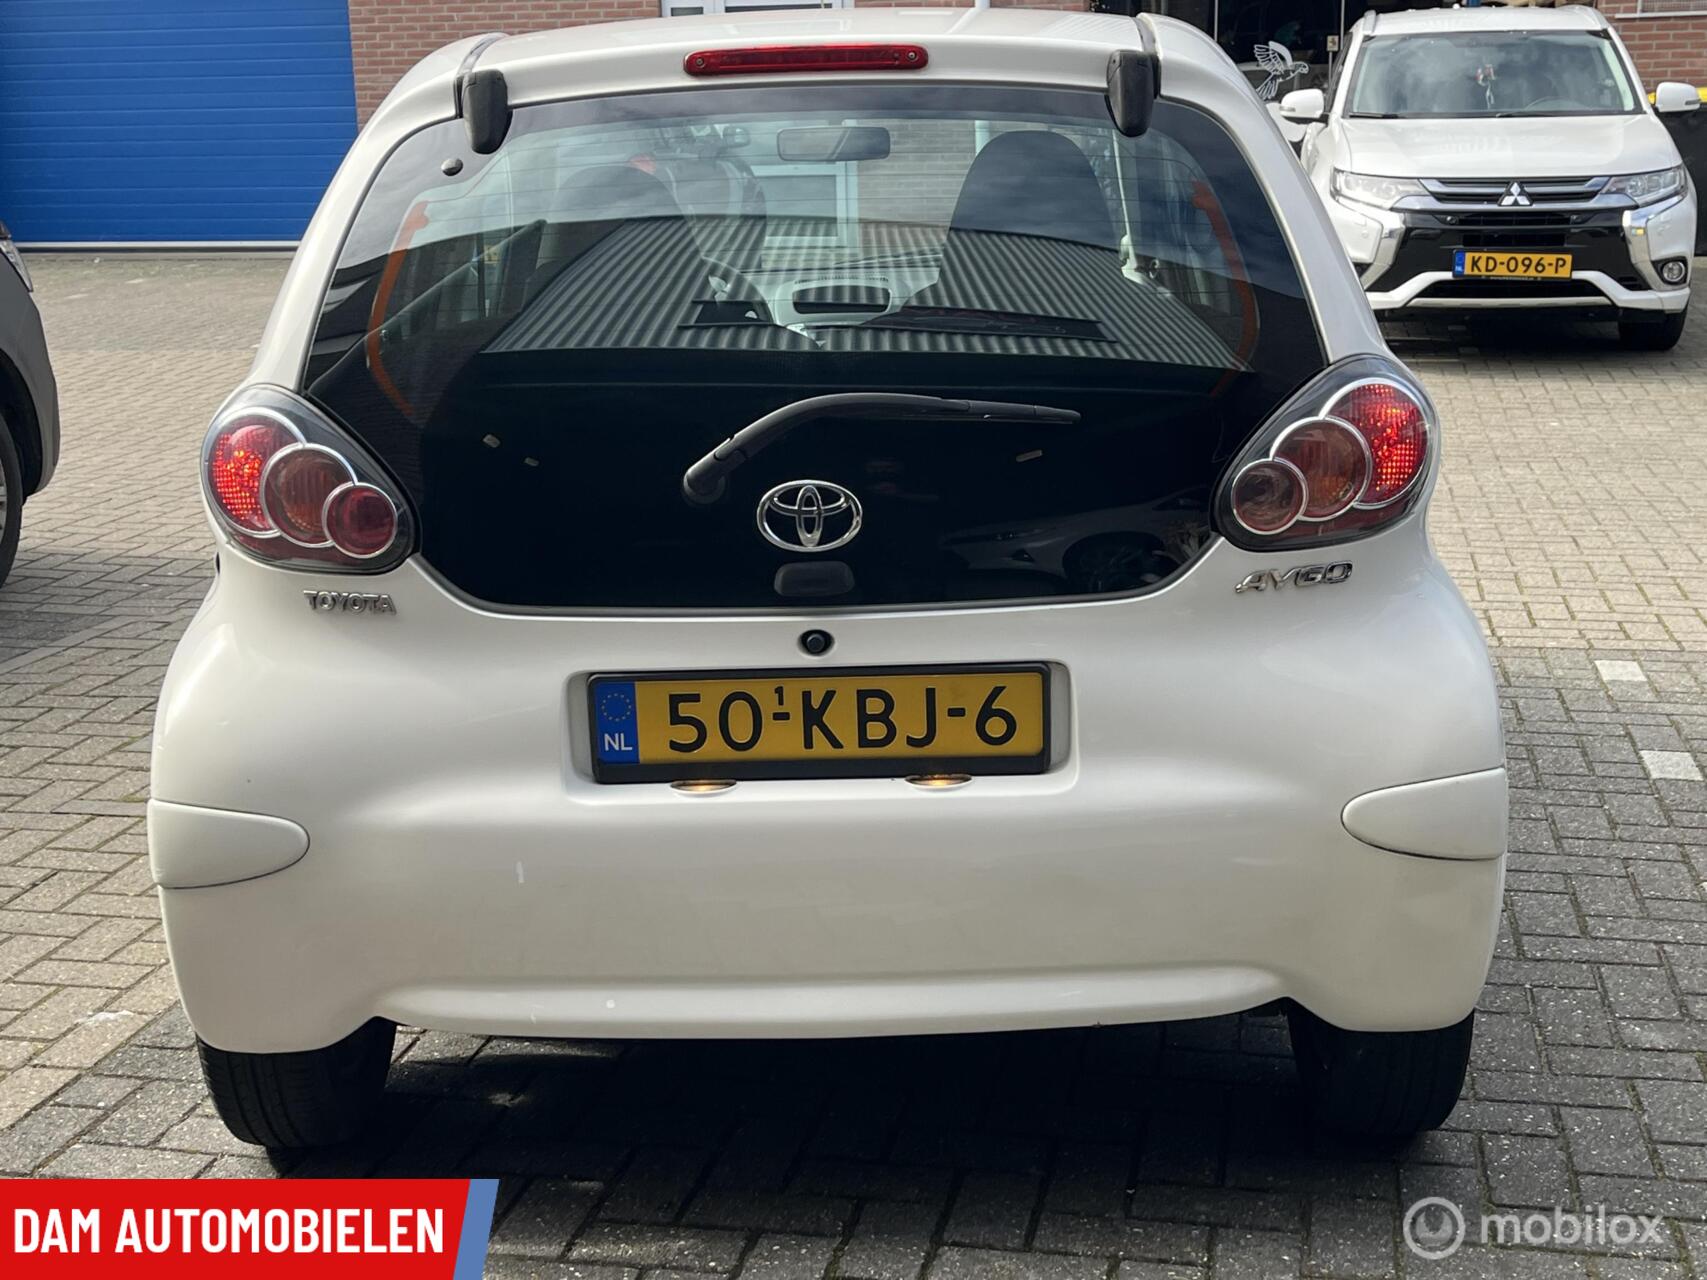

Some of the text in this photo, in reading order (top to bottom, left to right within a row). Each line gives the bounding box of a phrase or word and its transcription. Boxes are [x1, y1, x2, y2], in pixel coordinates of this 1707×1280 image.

[1471, 255, 1567, 274] KD-096-P
[1234, 560, 1353, 593] AYGO
[303, 590, 397, 615] TOYOTA
[603, 732, 633, 752] NL
